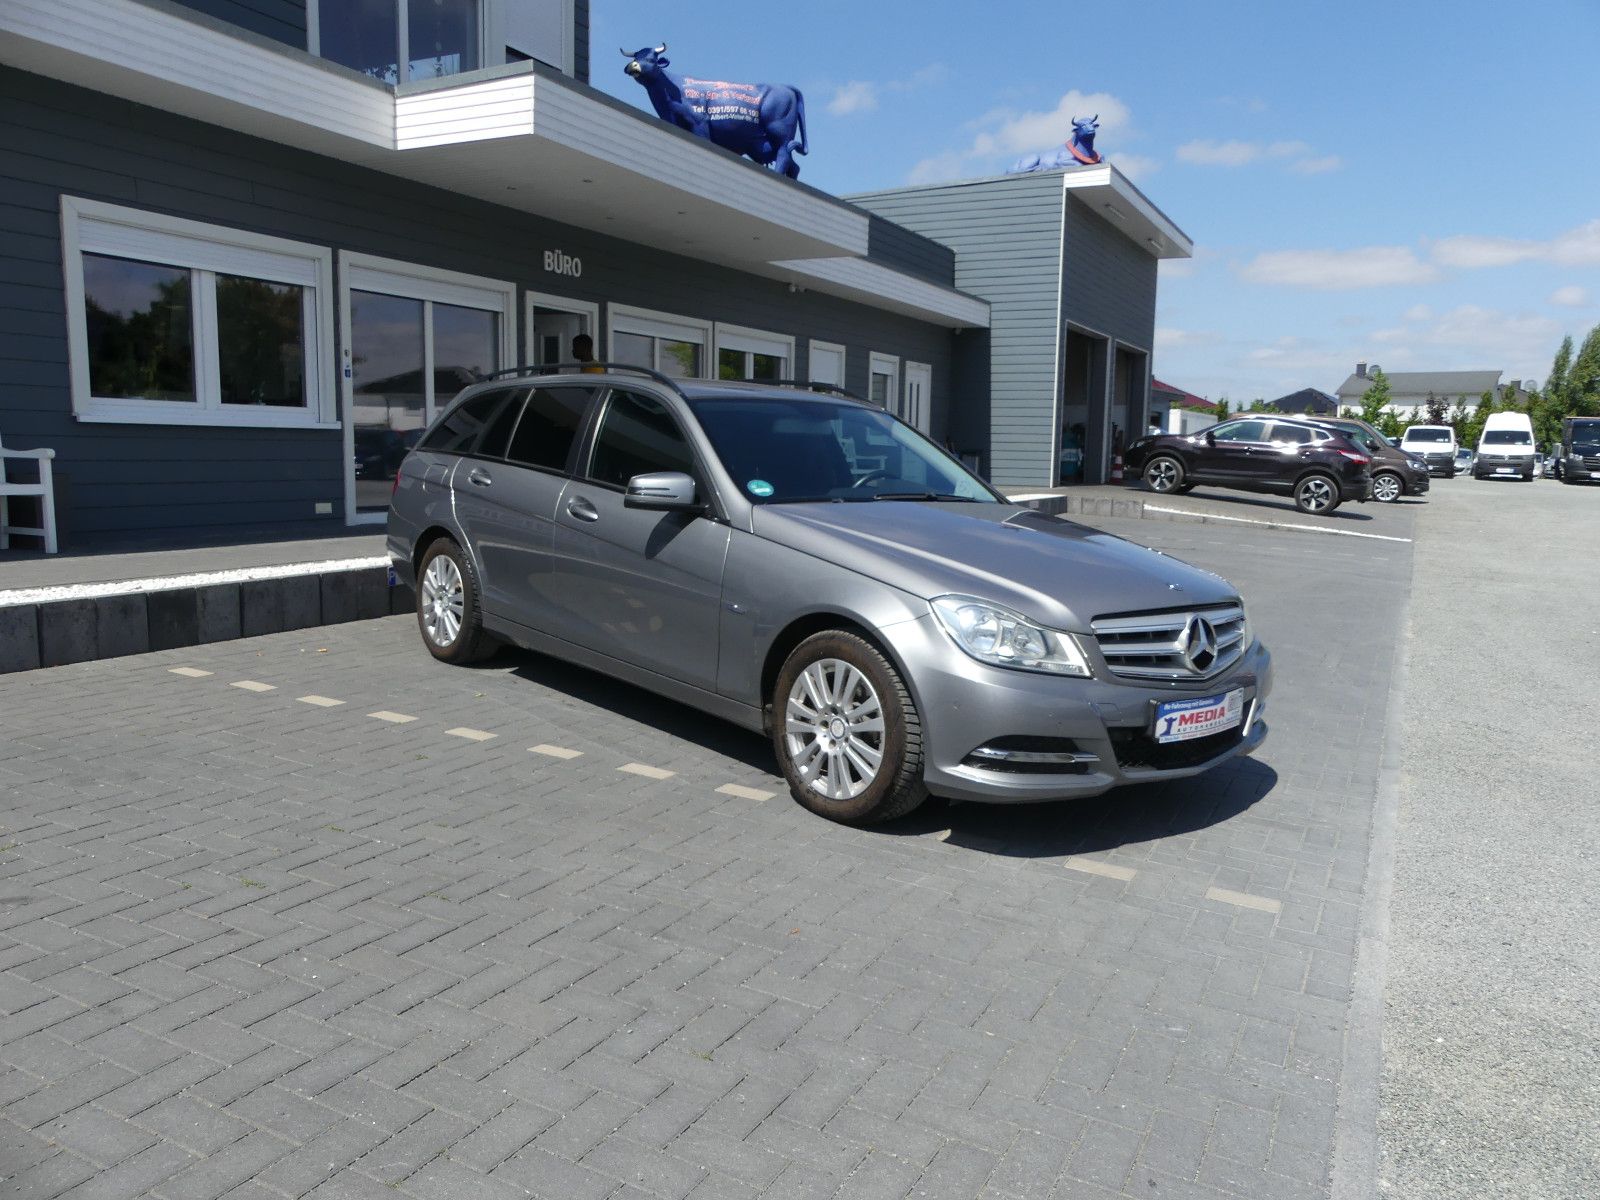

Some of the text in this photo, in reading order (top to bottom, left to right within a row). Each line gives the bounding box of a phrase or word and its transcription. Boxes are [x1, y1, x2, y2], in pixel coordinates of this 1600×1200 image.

[692, 105, 706, 113] Tel.
[544, 249, 582, 278] BÜRO
[1178, 706, 1226, 726] MEDIA
